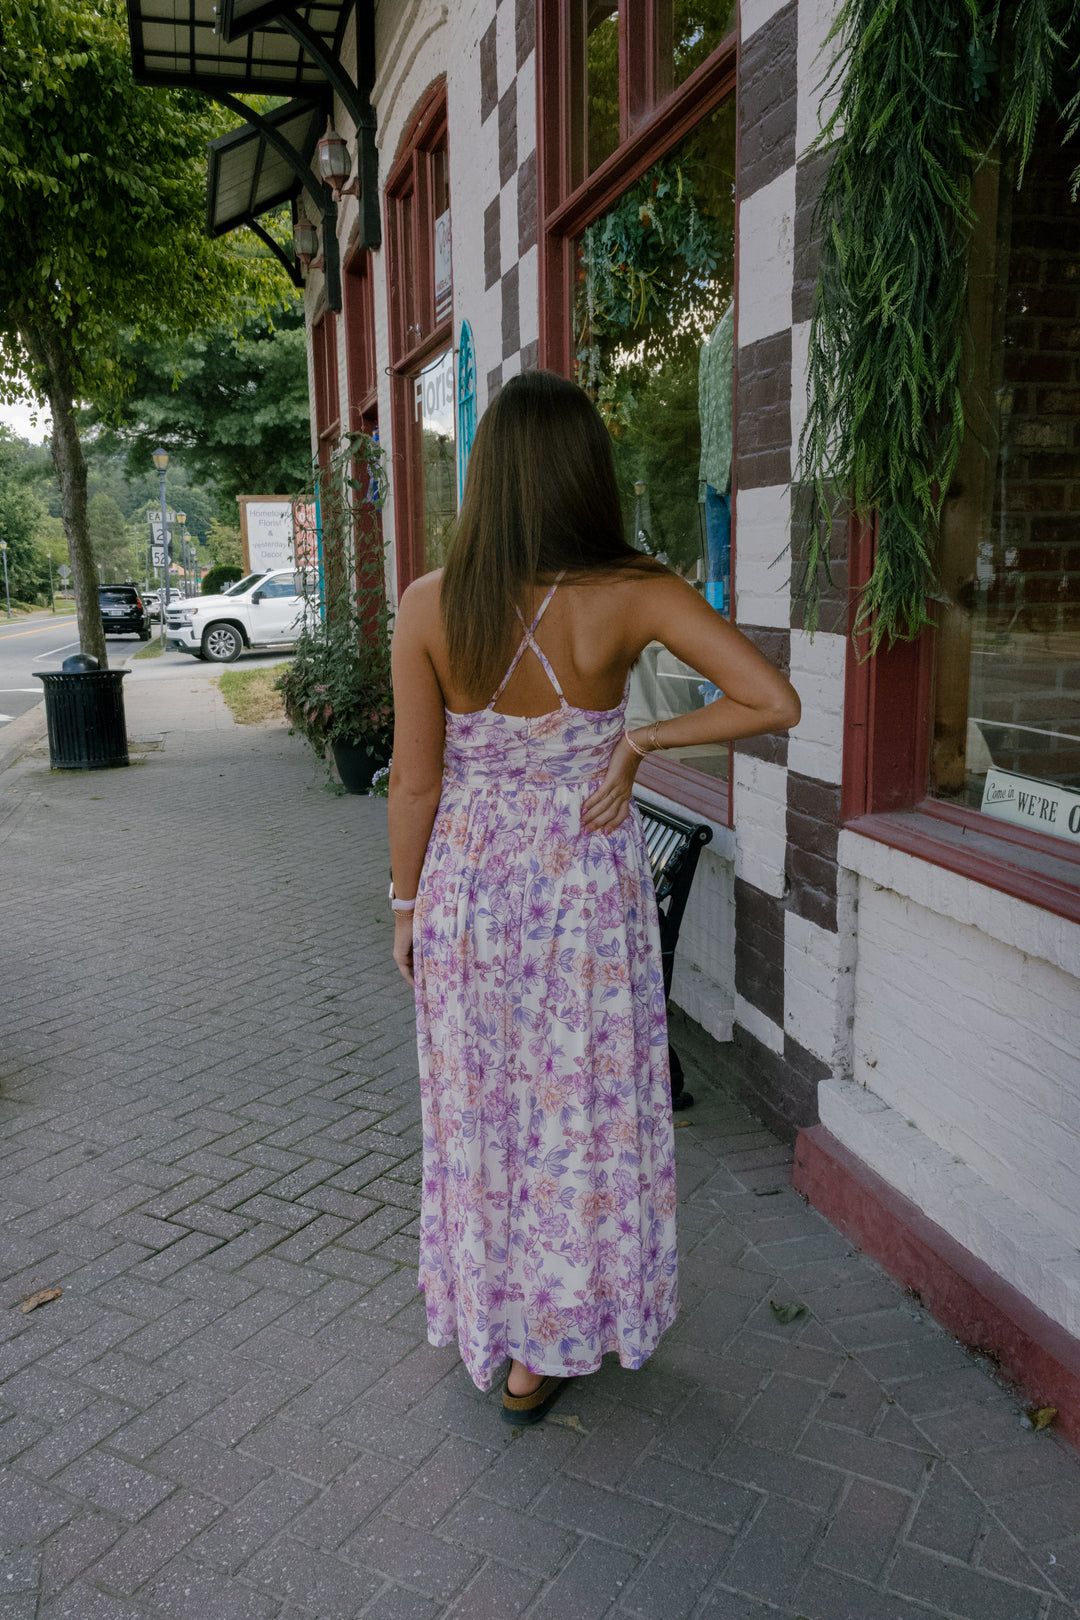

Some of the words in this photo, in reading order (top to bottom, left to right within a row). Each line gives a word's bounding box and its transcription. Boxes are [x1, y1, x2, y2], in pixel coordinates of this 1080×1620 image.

[149, 513, 173, 521] EAT
[987, 783, 1006, 801] Come
[1008, 785, 1015, 799] in
[1018, 792, 1058, 823] WE'RE
